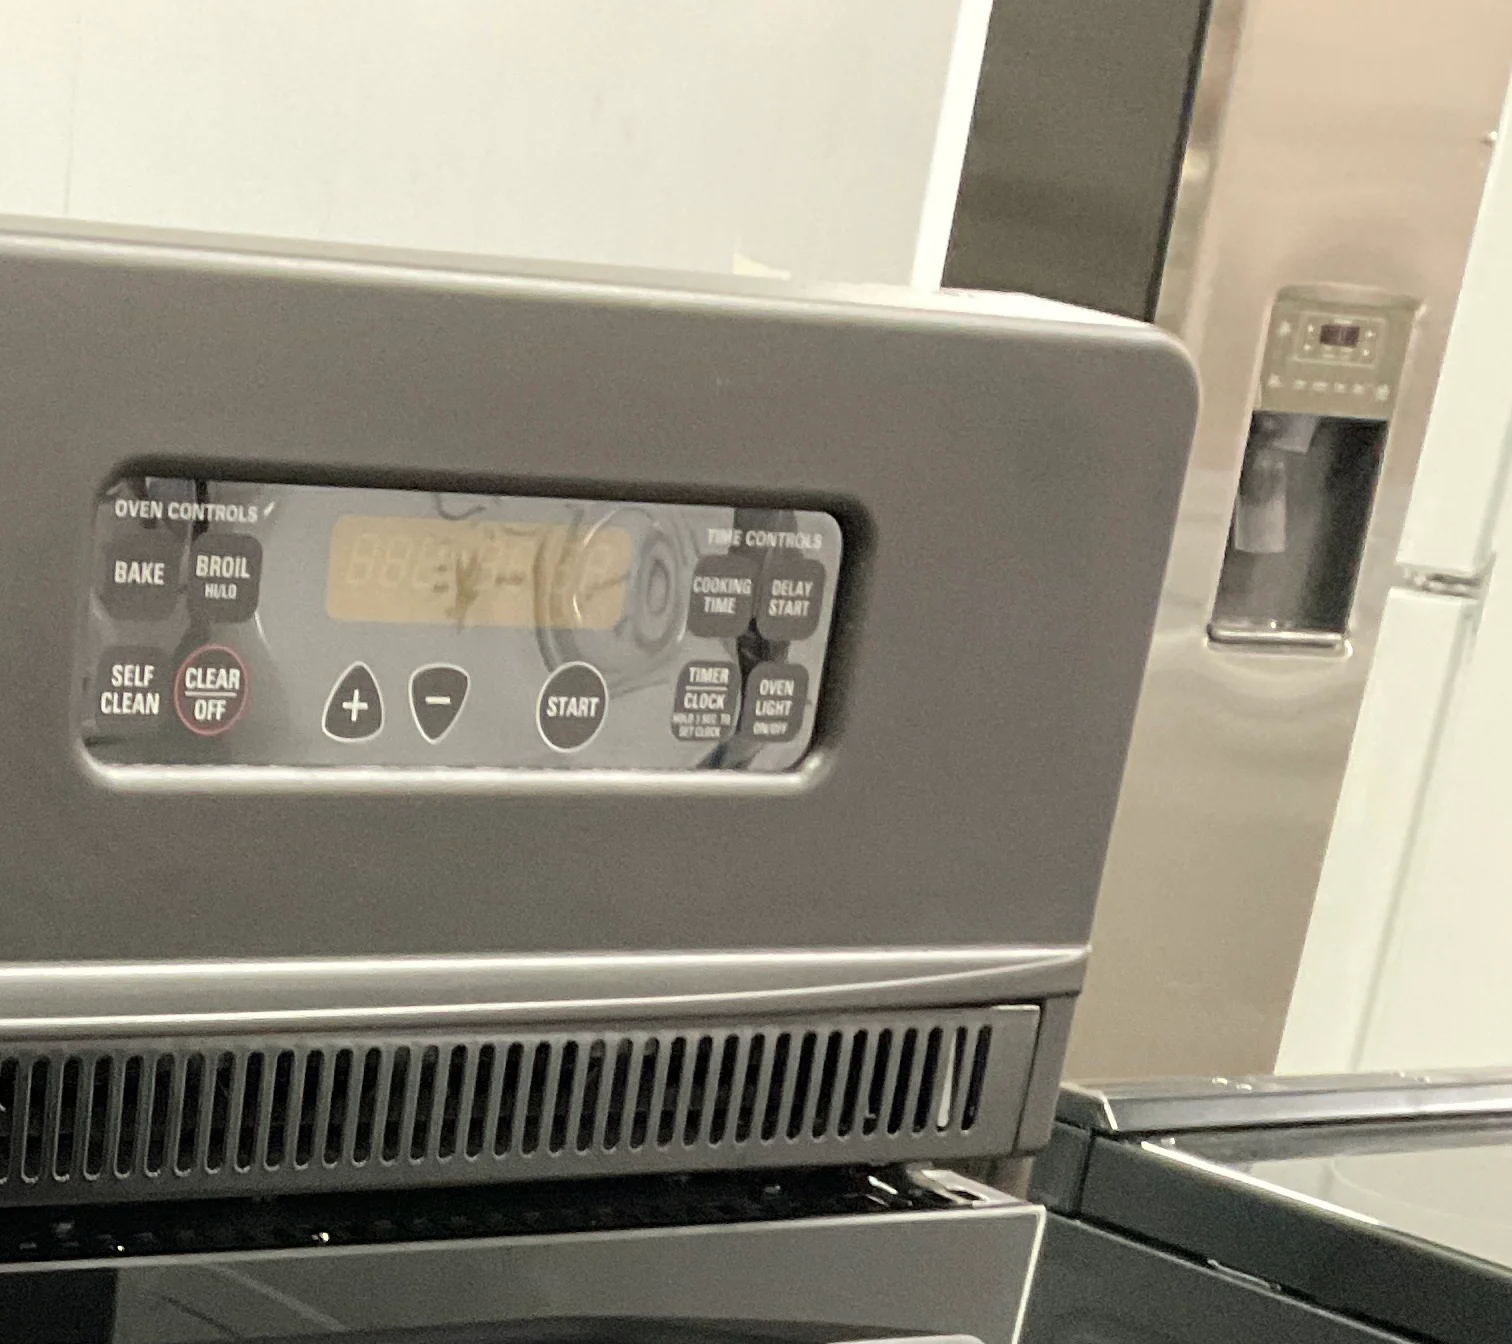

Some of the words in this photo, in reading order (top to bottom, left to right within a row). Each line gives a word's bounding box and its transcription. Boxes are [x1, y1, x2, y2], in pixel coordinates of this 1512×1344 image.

[115, 500, 163, 519] OVEN
[168, 502, 259, 523] CONTROLS
[708, 528, 743, 546] TIME
[745, 530, 823, 549] CONTROLS
[114, 560, 165, 585] BAKE
[196, 554, 250, 579] BROIL
[693, 576, 752, 595] COOKING
[771, 579, 814, 597] DELAY
[704, 596, 737, 614] TIME
[768, 599, 810, 616] START
[112, 664, 155, 687] SELF
[185, 667, 240, 690] CLEAR
[689, 667, 729, 683] TIMER
[759, 679, 794, 696] OVEN
[101, 692, 160, 715] CLEAN
[194, 699, 226, 722] OFF
[547, 696, 599, 718] START
[684, 692, 726, 710] CLOCK
[755, 700, 793, 716] LIGHT
